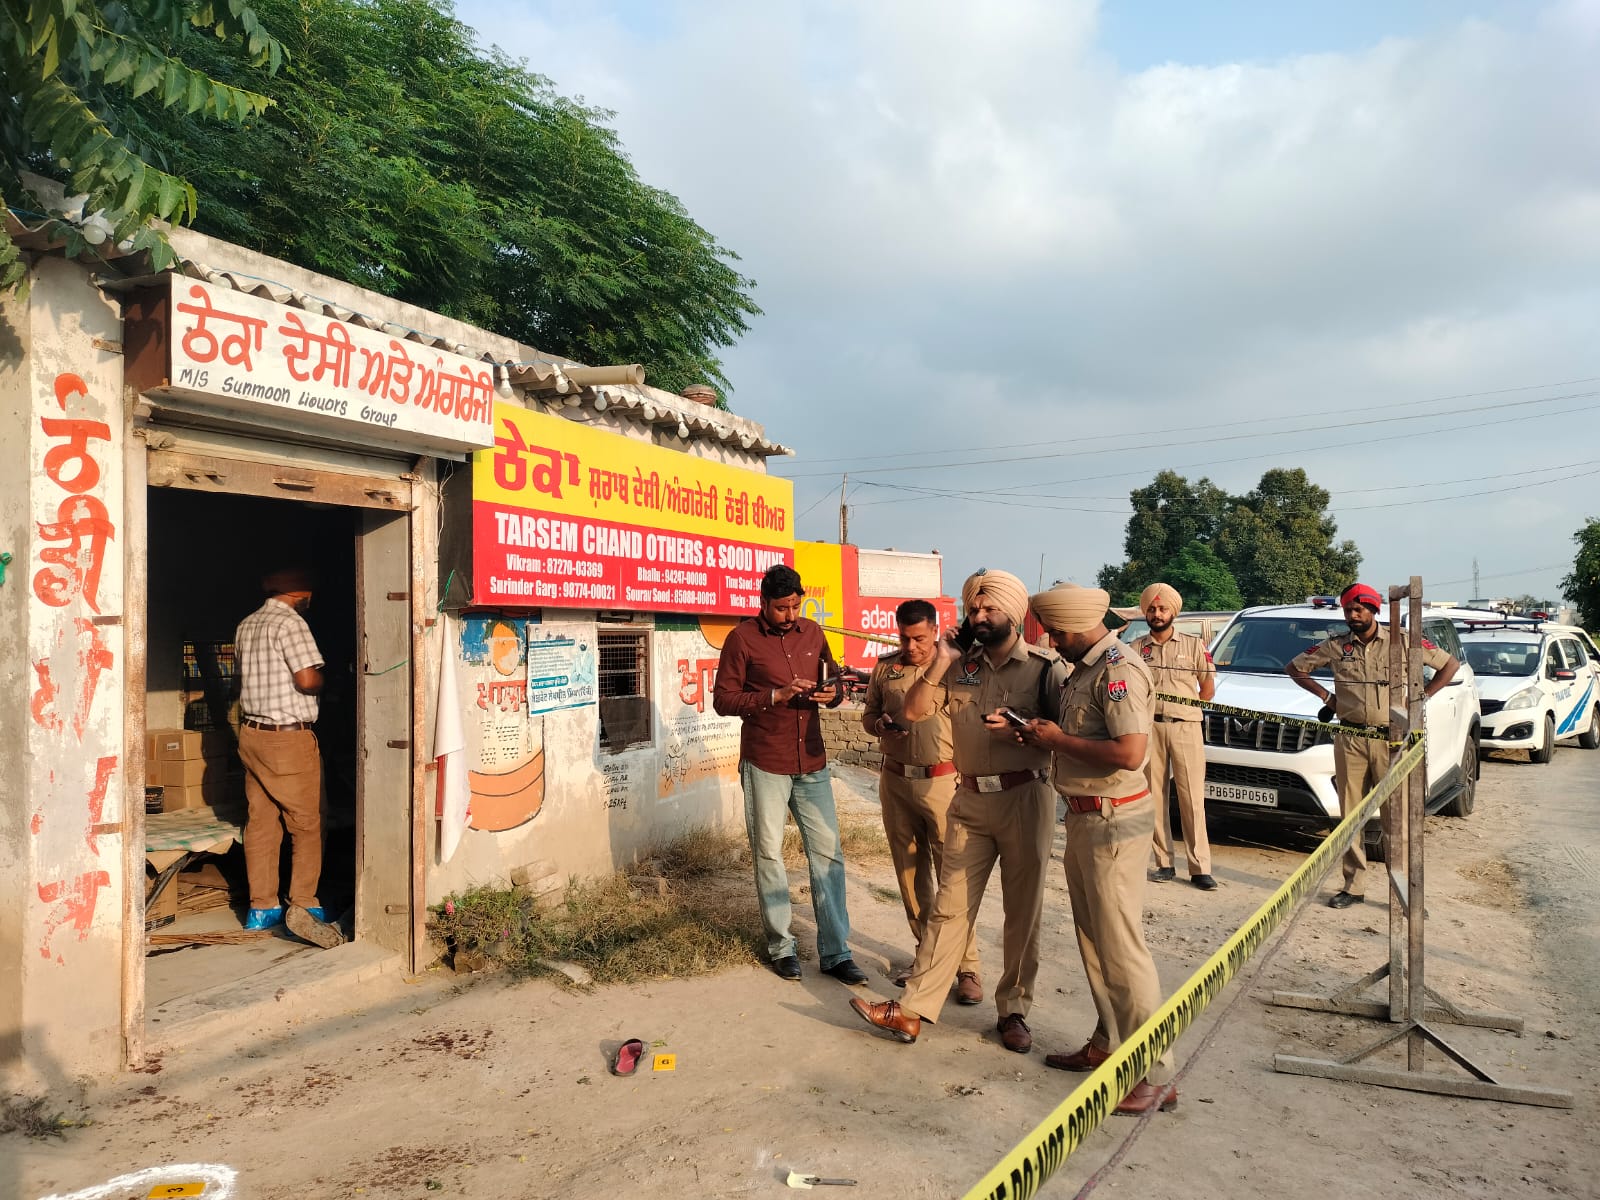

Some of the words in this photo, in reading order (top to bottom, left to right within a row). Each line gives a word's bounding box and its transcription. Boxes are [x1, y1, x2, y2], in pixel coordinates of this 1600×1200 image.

[176, 284, 268, 372] ਠੇਕਾ
[278, 311, 356, 388] ਦੇਸੀ
[358, 340, 415, 404] ਅਤੇ
[179, 368, 209, 388] M/S
[221, 377, 291, 404] Sunmoon
[493, 418, 581, 500] ਠੇਕਾ
[724, 487, 749, 526] ਠੰਡੀ
[495, 511, 579, 554] TARSEM
[582, 524, 643, 560] CHAND
[646, 532, 703, 567] OTHERS
[706, 546, 716, 567] &
[718, 544, 753, 572] SOOD
[506, 553, 541, 573] Vikram
[490, 576, 534, 595] Surinder
[535, 580, 558, 599] Garg
[652, 588, 671, 603] Sood
[861, 604, 897, 629] adan
[1209, 785, 1275, 803] PB65BP0569
